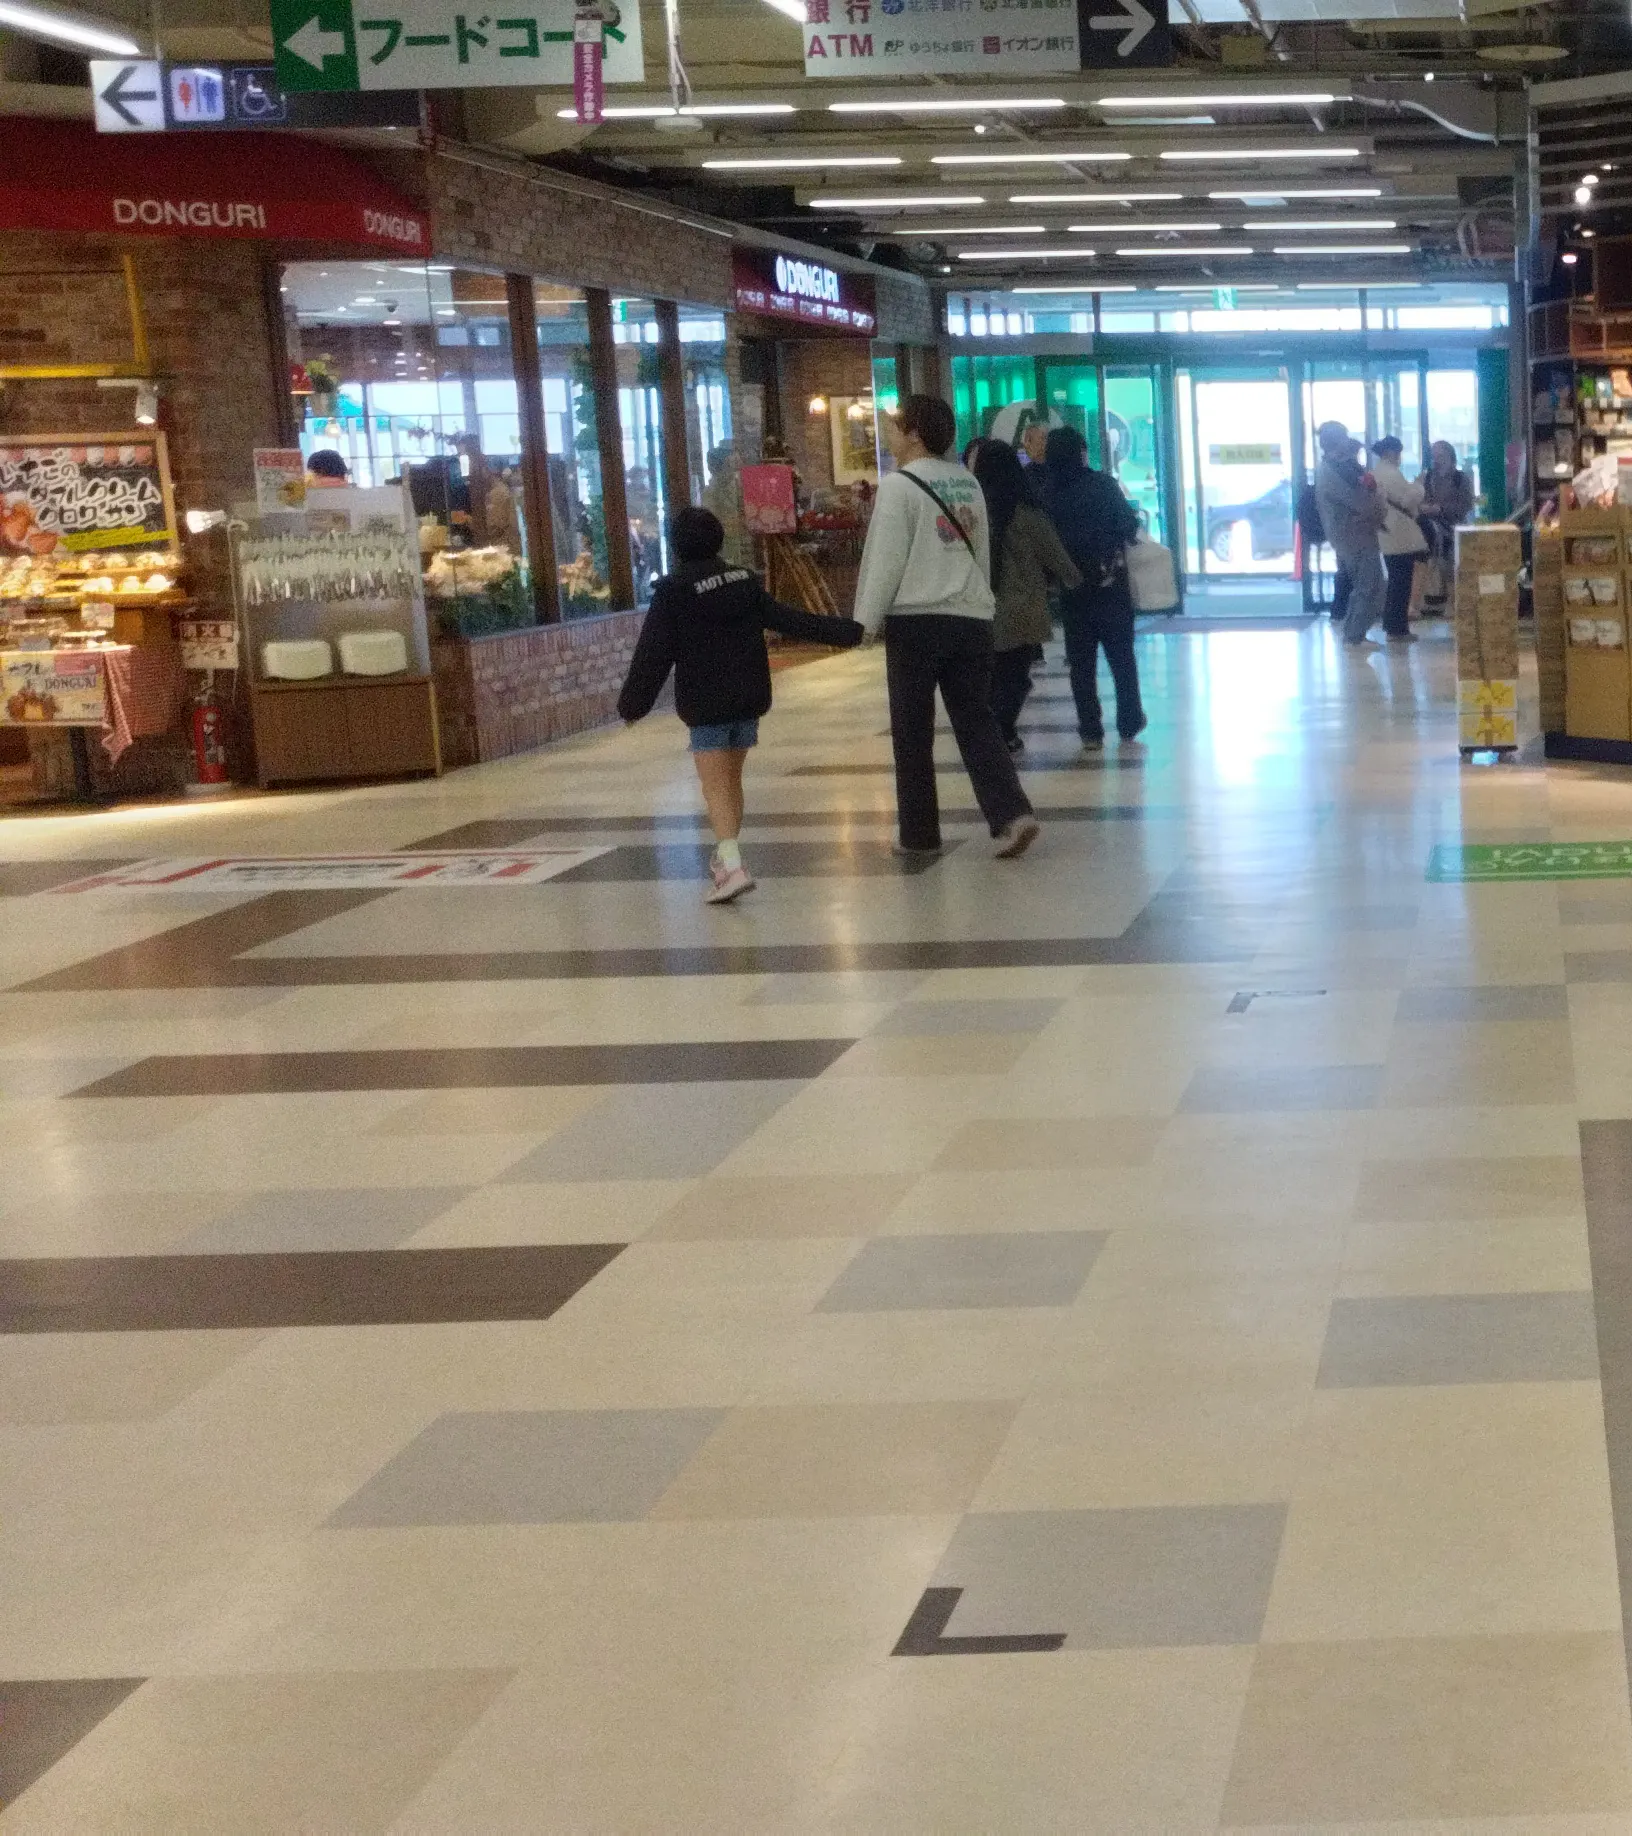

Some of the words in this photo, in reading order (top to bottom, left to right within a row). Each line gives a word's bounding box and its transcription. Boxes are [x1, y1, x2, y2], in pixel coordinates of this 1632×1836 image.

[360, 15, 627, 65] フードコート
[807, 34, 874, 59] ATM
[1003, 36, 1074, 52] イオン銀行
[113, 199, 266, 229] DONGURI
[363, 208, 422, 244] DONGURI
